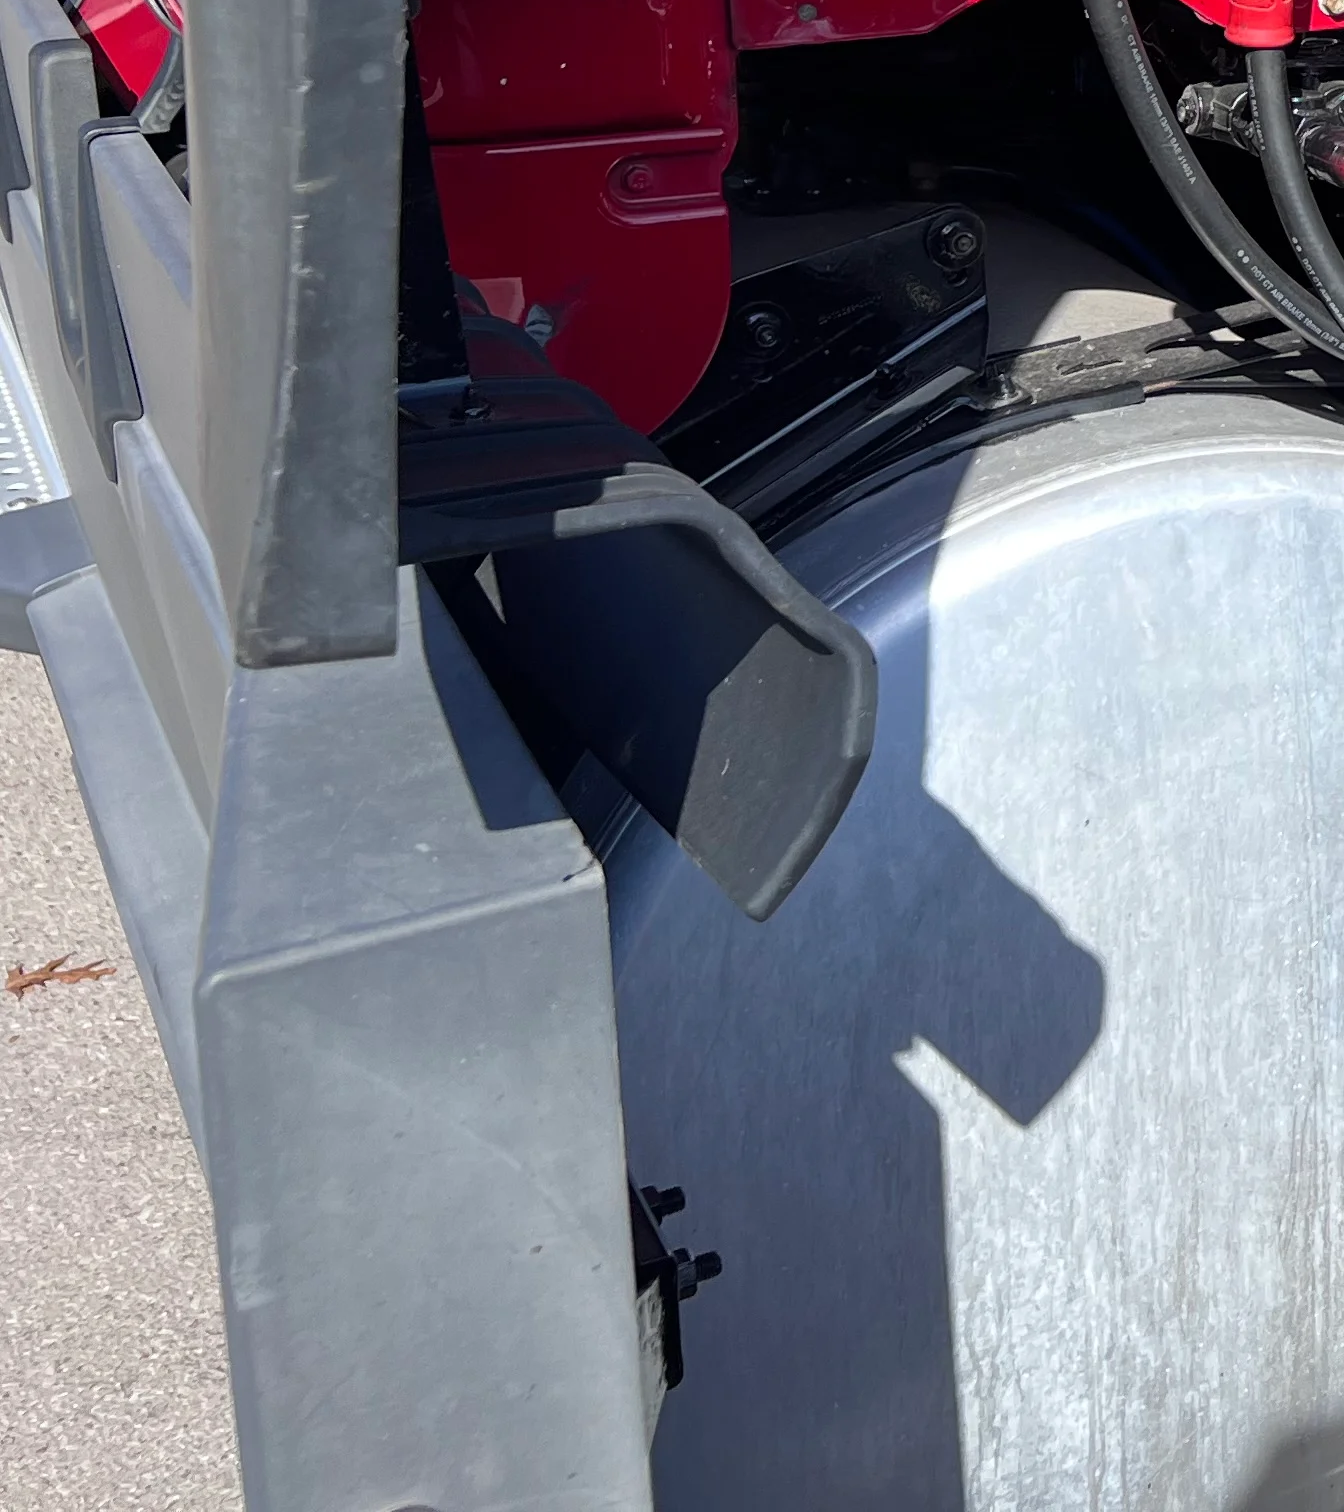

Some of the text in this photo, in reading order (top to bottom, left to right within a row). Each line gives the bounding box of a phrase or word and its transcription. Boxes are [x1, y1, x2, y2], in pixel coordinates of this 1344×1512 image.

[1131, 48, 1142, 64] AIR
[1137, 63, 1154, 93] BRAKE
[1250, 265, 1266, 283] DOT
[1262, 278, 1273, 291] CT
[1269, 288, 1285, 304] AIR
[1280, 298, 1306, 322] BRAKE
[1302, 317, 1323, 336] 10mm
[1302, 258, 1316, 278] DOT
[1319, 287, 1332, 303] AIR
